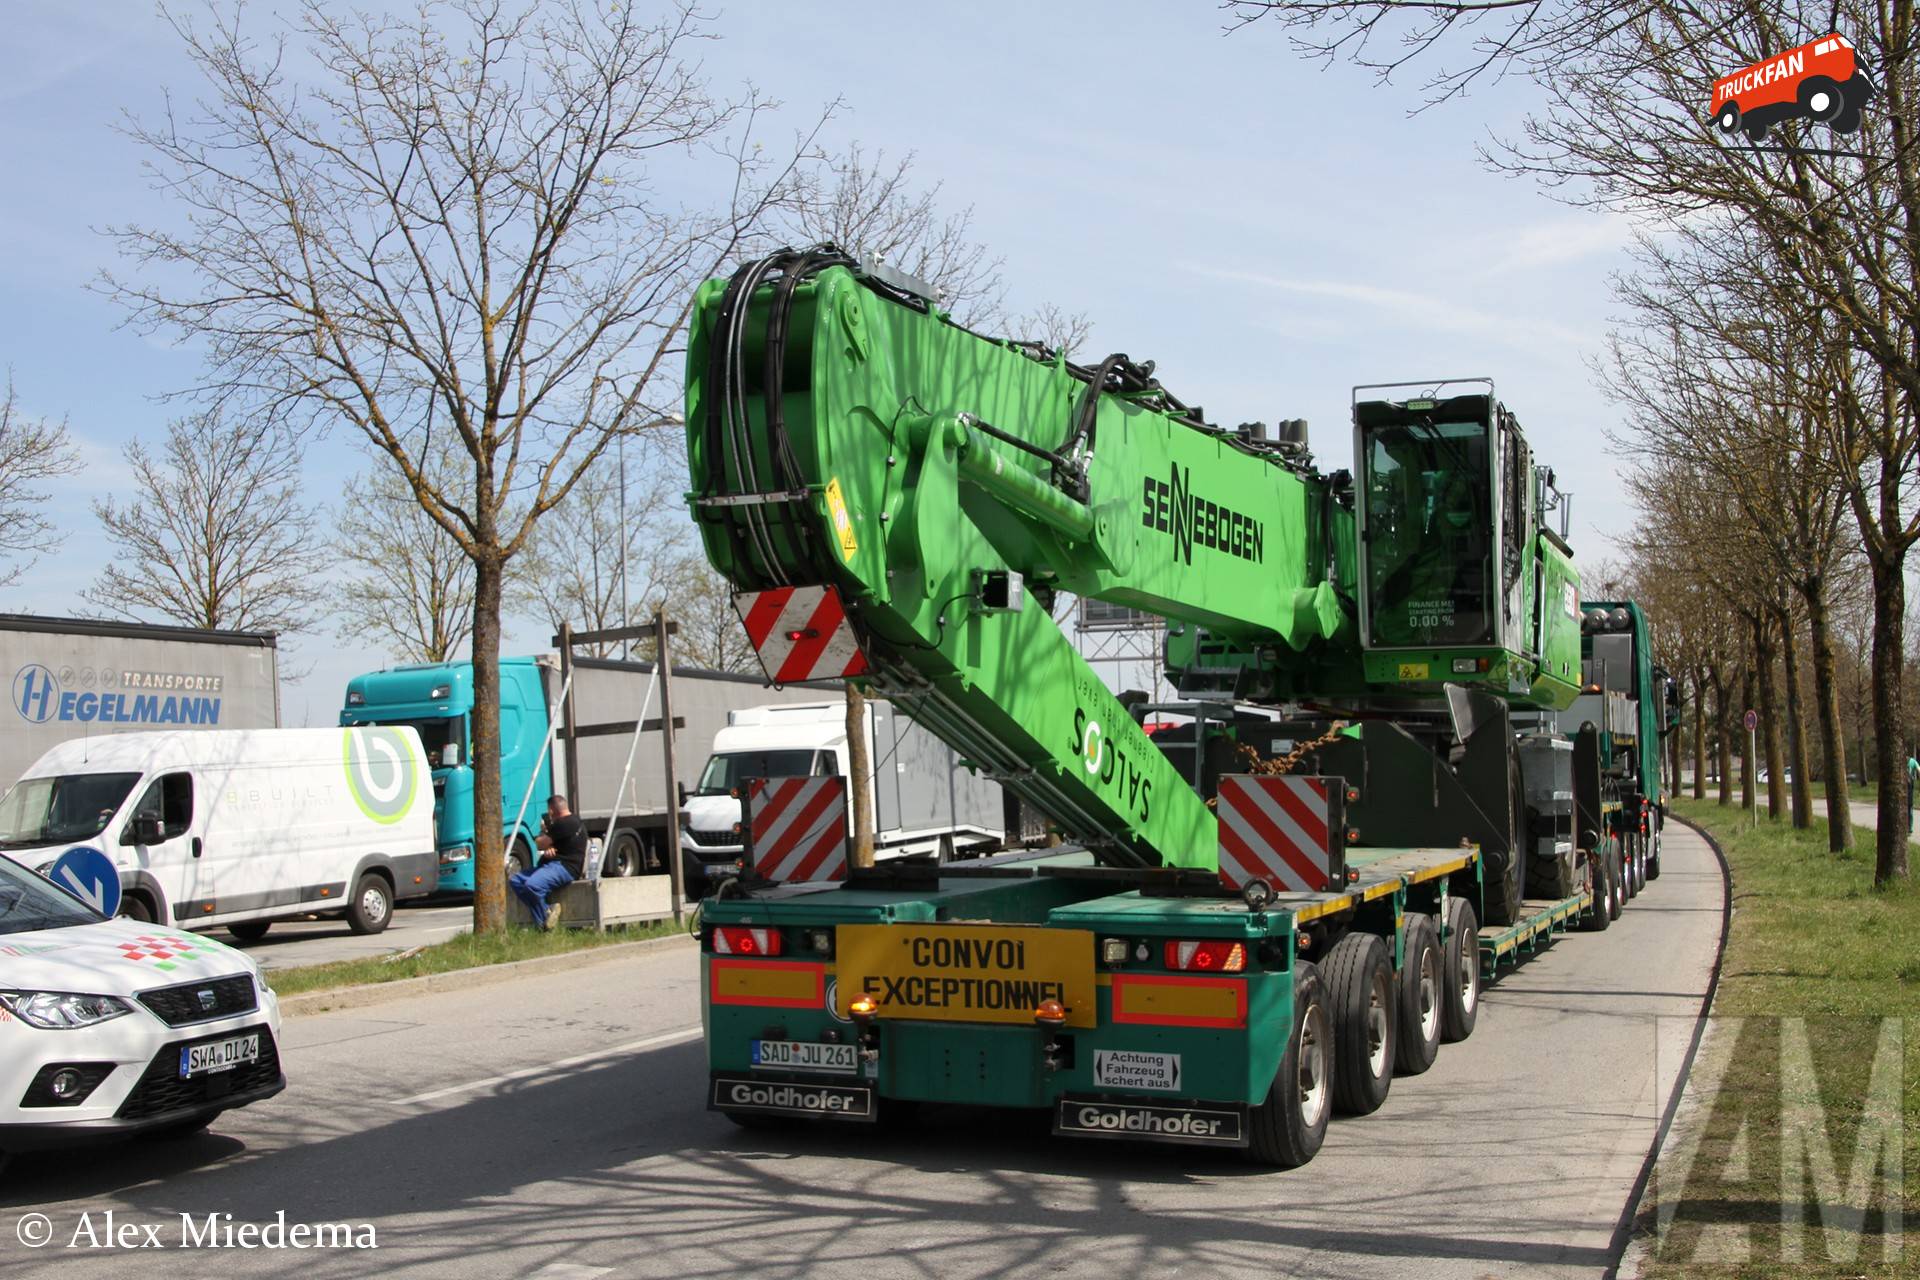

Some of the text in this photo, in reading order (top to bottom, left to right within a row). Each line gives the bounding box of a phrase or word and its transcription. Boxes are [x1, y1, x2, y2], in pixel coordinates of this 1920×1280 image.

[1142, 460, 1263, 566] SENNEBOGEN
[1409, 615, 1439, 628] 0.00
[123, 671, 221, 691] TRANSPORTE
[912, 937, 1025, 970] CONVOI
[863, 976, 1073, 1013] EXCEPTIONNEL
[190, 1038, 257, 1069] SWA DI 24
[761, 1042, 855, 1066] SAD JU 261
[1110, 1052, 1164, 1067] Achtung
[1104, 1076, 1170, 1088] schert aus
[1106, 1063, 1165, 1079] Fahrzeug
[730, 1084, 854, 1111] Goldhofer
[1078, 1106, 1222, 1135] Goldhofer
